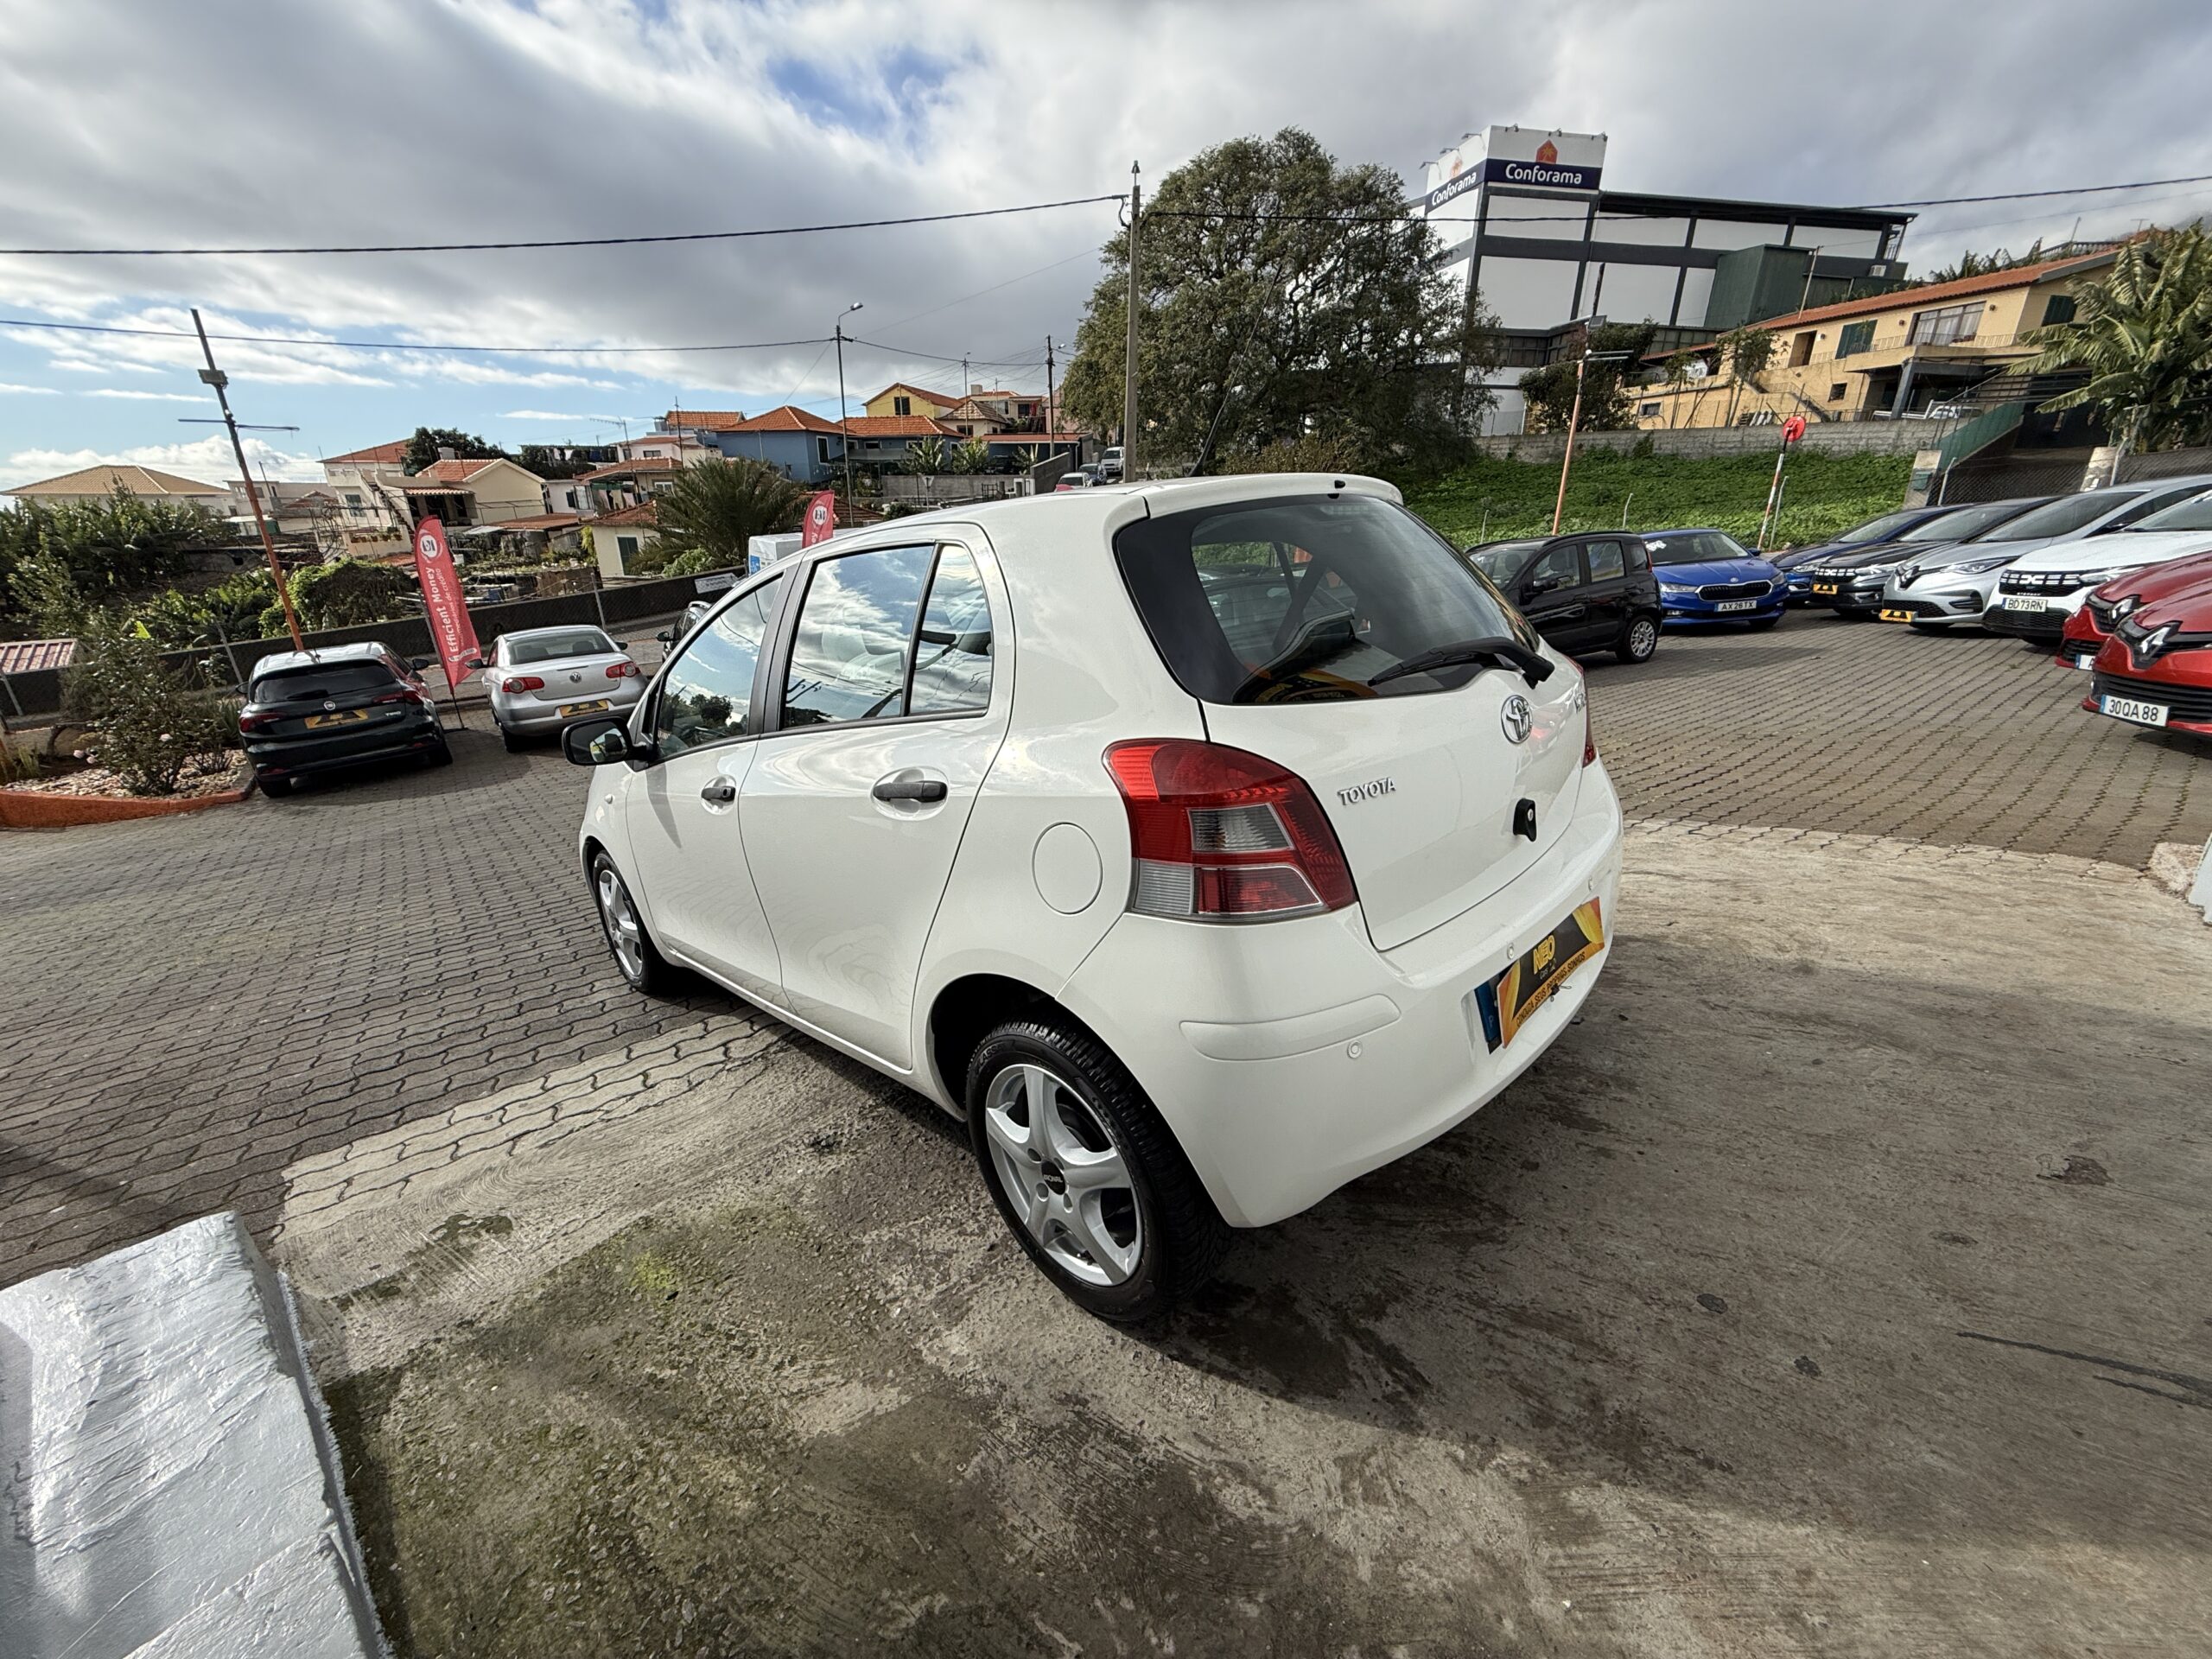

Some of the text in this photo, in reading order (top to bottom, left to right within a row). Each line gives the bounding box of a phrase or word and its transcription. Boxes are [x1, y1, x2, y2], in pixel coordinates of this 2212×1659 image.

[1432, 172, 1477, 206] Conforama
[1505, 163, 1582, 185] Conforama
[425, 567, 458, 652] Efficient Money
[1338, 777, 1396, 805] TOYOTA
[1533, 935, 1555, 975] NEO
